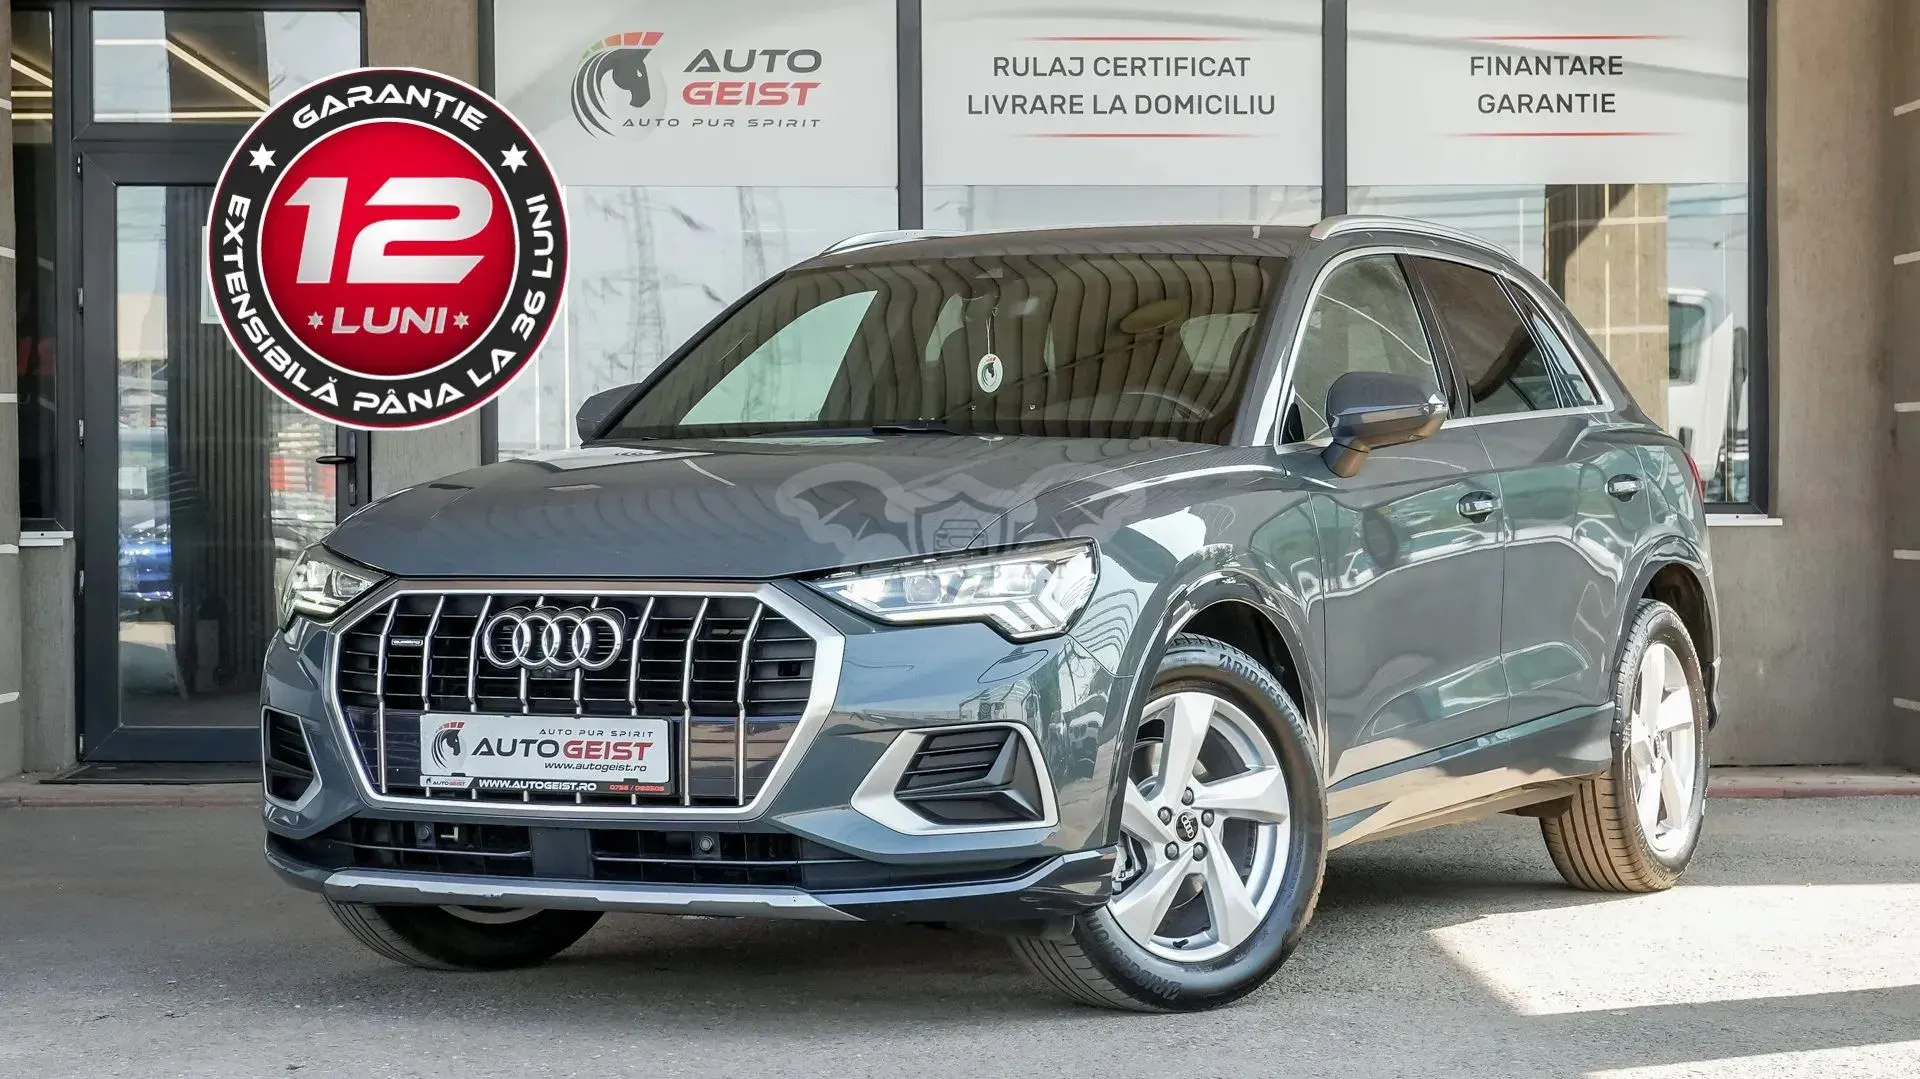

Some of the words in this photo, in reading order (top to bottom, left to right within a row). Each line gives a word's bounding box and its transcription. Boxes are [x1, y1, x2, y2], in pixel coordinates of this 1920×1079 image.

[683, 49, 822, 73] AUTO
[993, 56, 1084, 77] RULAJ
[1093, 56, 1251, 77] CERTIFICAT
[1470, 55, 1624, 76] FINANTARE
[683, 81, 822, 106] GEIST
[1477, 93, 1616, 114] GARANTIE
[968, 94, 1084, 115] LIVRARE
[1093, 94, 1128, 115] LA
[1135, 94, 1275, 115] DOMICILIU
[622, 118, 680, 127] AUTO
[692, 118, 735, 127] PUR
[747, 118, 822, 128] SPIRIT
[539, 728, 573, 736] AUTO
[579, 729, 604, 737] PUR
[611, 730, 654, 738] SPIRIT
[544, 761, 648, 772] www.autogeist.ro
[478, 778, 597, 791] WWW.AUTOGEIST.RO
